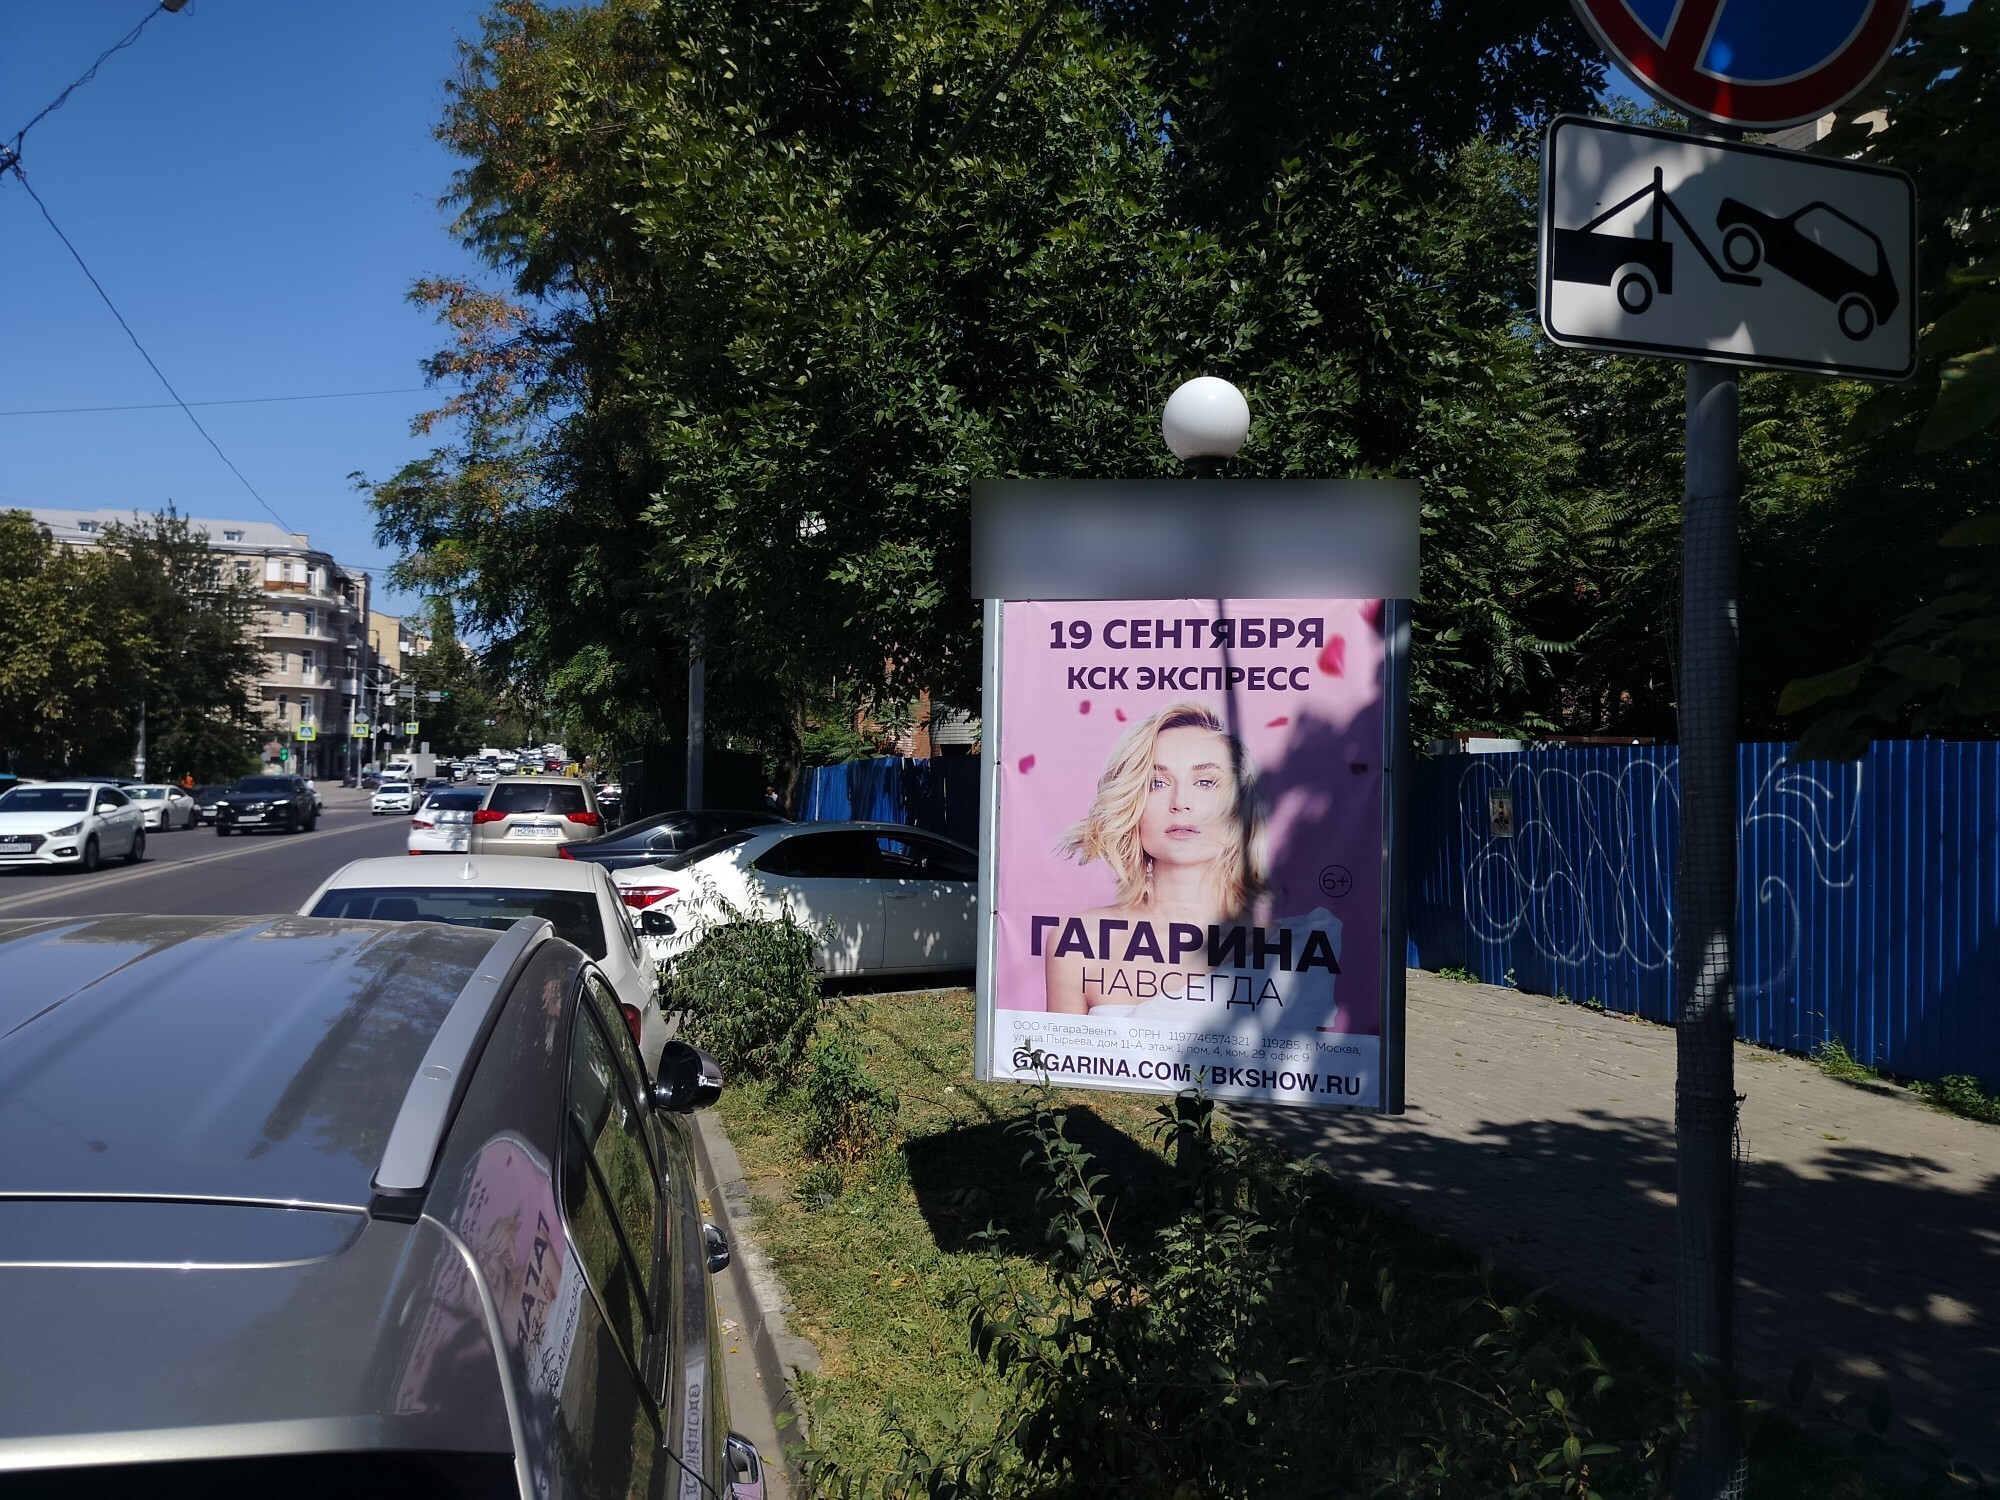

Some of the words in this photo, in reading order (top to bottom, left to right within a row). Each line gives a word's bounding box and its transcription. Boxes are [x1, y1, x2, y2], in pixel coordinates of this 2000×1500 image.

[1050, 619, 1093, 650] 19
[1102, 617, 1325, 650] СЕНТЯБРЯ
[1067, 666, 1130, 690] КСК
[1136, 666, 1310, 691] ЭКСПРЕСС
[1322, 872, 1349, 890] 6+
[1031, 915, 1342, 975] ГАГАРИНА
[1082, 966, 1284, 1012] НАВСЕГДА
[1013, 1020, 1040, 1031] ООО
[1042, 1022, 1117, 1037] «ГагараЭвент»
[1128, 1028, 1161, 1039] ОГРН
[1169, 1031, 1250, 1047] 1197746574321
[1261, 1038, 1303, 1051] 119285,
[1315, 1041, 1362, 1056] Москва,
[1013, 1032, 1044, 1044] улица
[1096, 1039, 1118, 1049] дом
[1148, 1042, 1174, 1053] этаж
[1186, 1046, 1211, 1056] пом.
[1225, 1048, 1249, 1059] ком.
[1251, 1048, 1268, 1060] 29,
[1270, 1051, 1300, 1063] офис
[1302, 1052, 1310, 1062] 9
[1211, 1065, 1361, 1096] BKSHOW.RU
